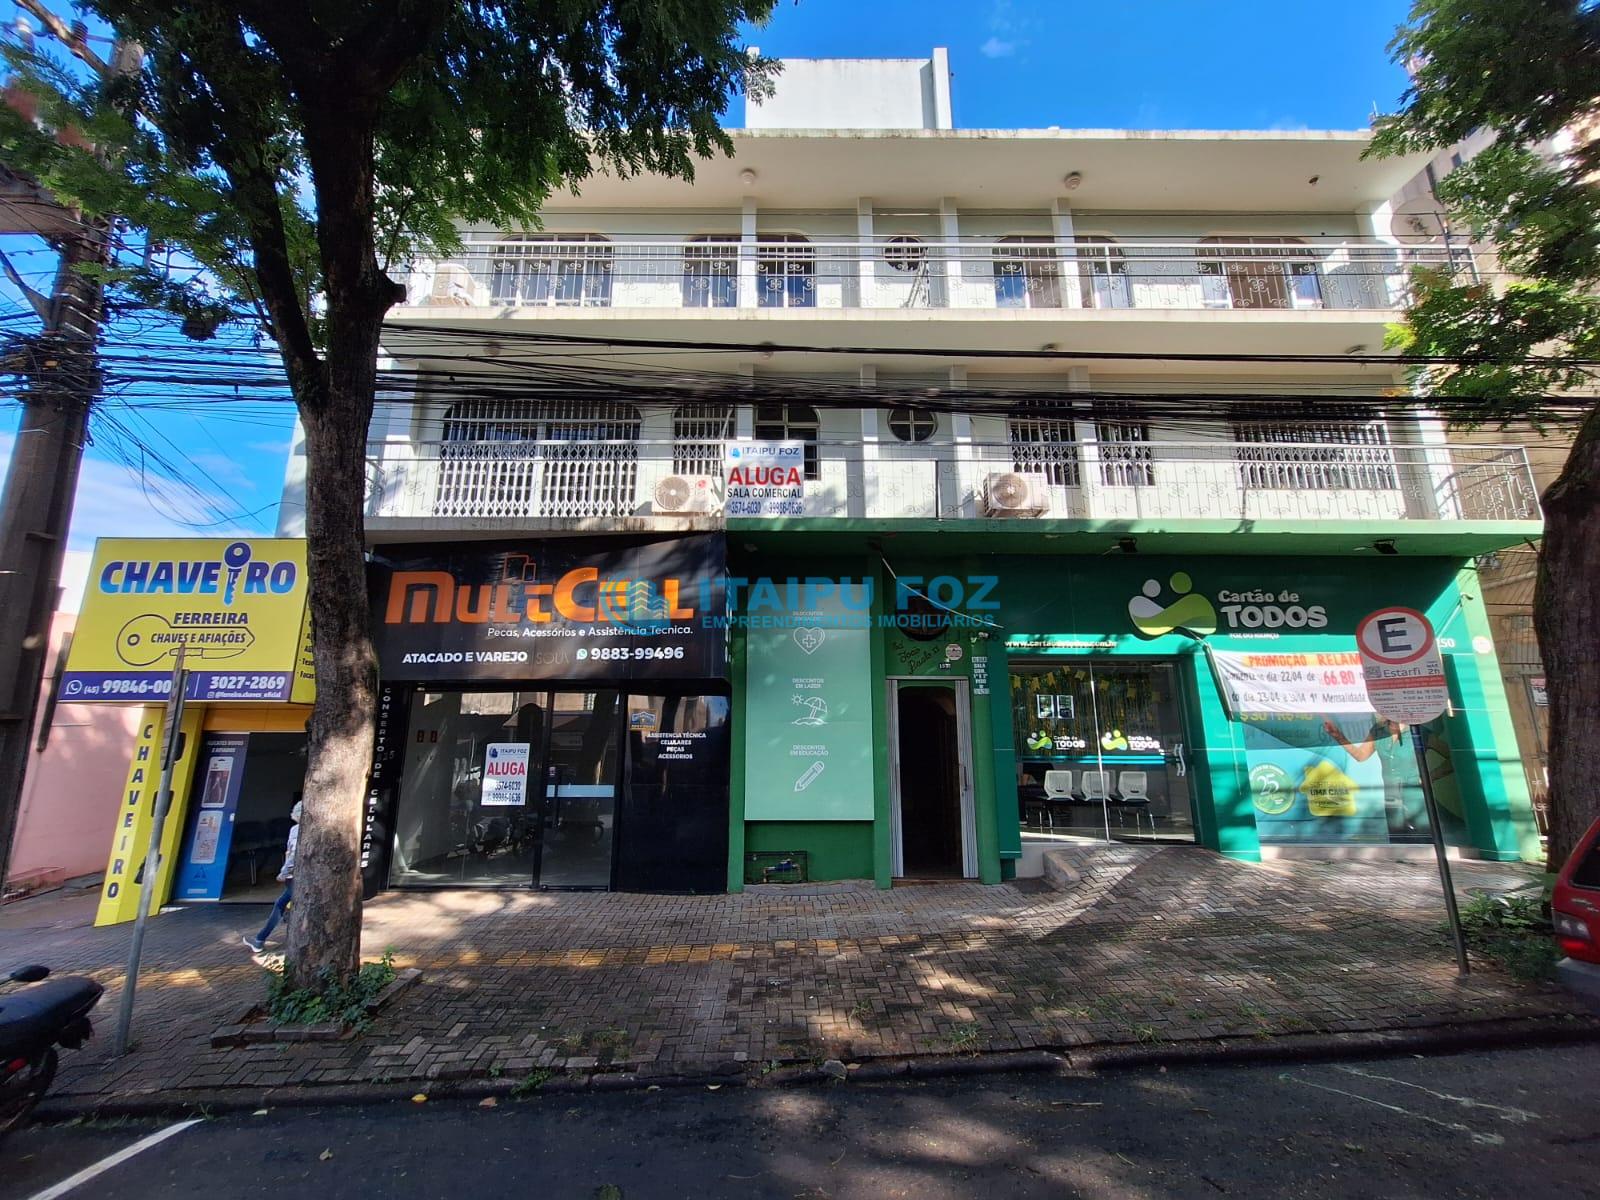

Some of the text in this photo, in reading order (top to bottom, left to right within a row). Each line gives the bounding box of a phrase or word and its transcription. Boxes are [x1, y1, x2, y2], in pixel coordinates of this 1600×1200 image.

[728, 467, 801, 486] ALUGA
[728, 488, 801, 498] SALA COMERCIAL
[100, 542, 296, 606] CHAVEIRO
[1218, 590, 1299, 603] Cartão de
[173, 612, 248, 625] FERREIRA
[1220, 605, 1328, 628] TODOS
[522, 626, 577, 637] Acessórios
[1377, 617, 1412, 653] E
[151, 631, 245, 646] CHAVES E AFIAÇÕES
[402, 652, 462, 663] ATACADO
[466, 652, 473, 662] E
[475, 651, 528, 662] VAREJO
[591, 647, 684, 660] 9883-99496
[1248, 655, 1307, 668] PROMOÇÃO
[1306, 671, 1315, 681] de
[1323, 670, 1355, 685] 66.80
[1383, 667, 1421, 677] Estarfi
[210, 676, 285, 690] 3027-2869
[1054, 740, 1085, 748] TODOS
[1128, 740, 1160, 748] TODOS
[487, 762, 525, 775] ALUGA
[1257, 774, 1280, 795] 25
[107, 724, 153, 898] CHAVEIRO
[360, 789, 378, 868] CELULARES
